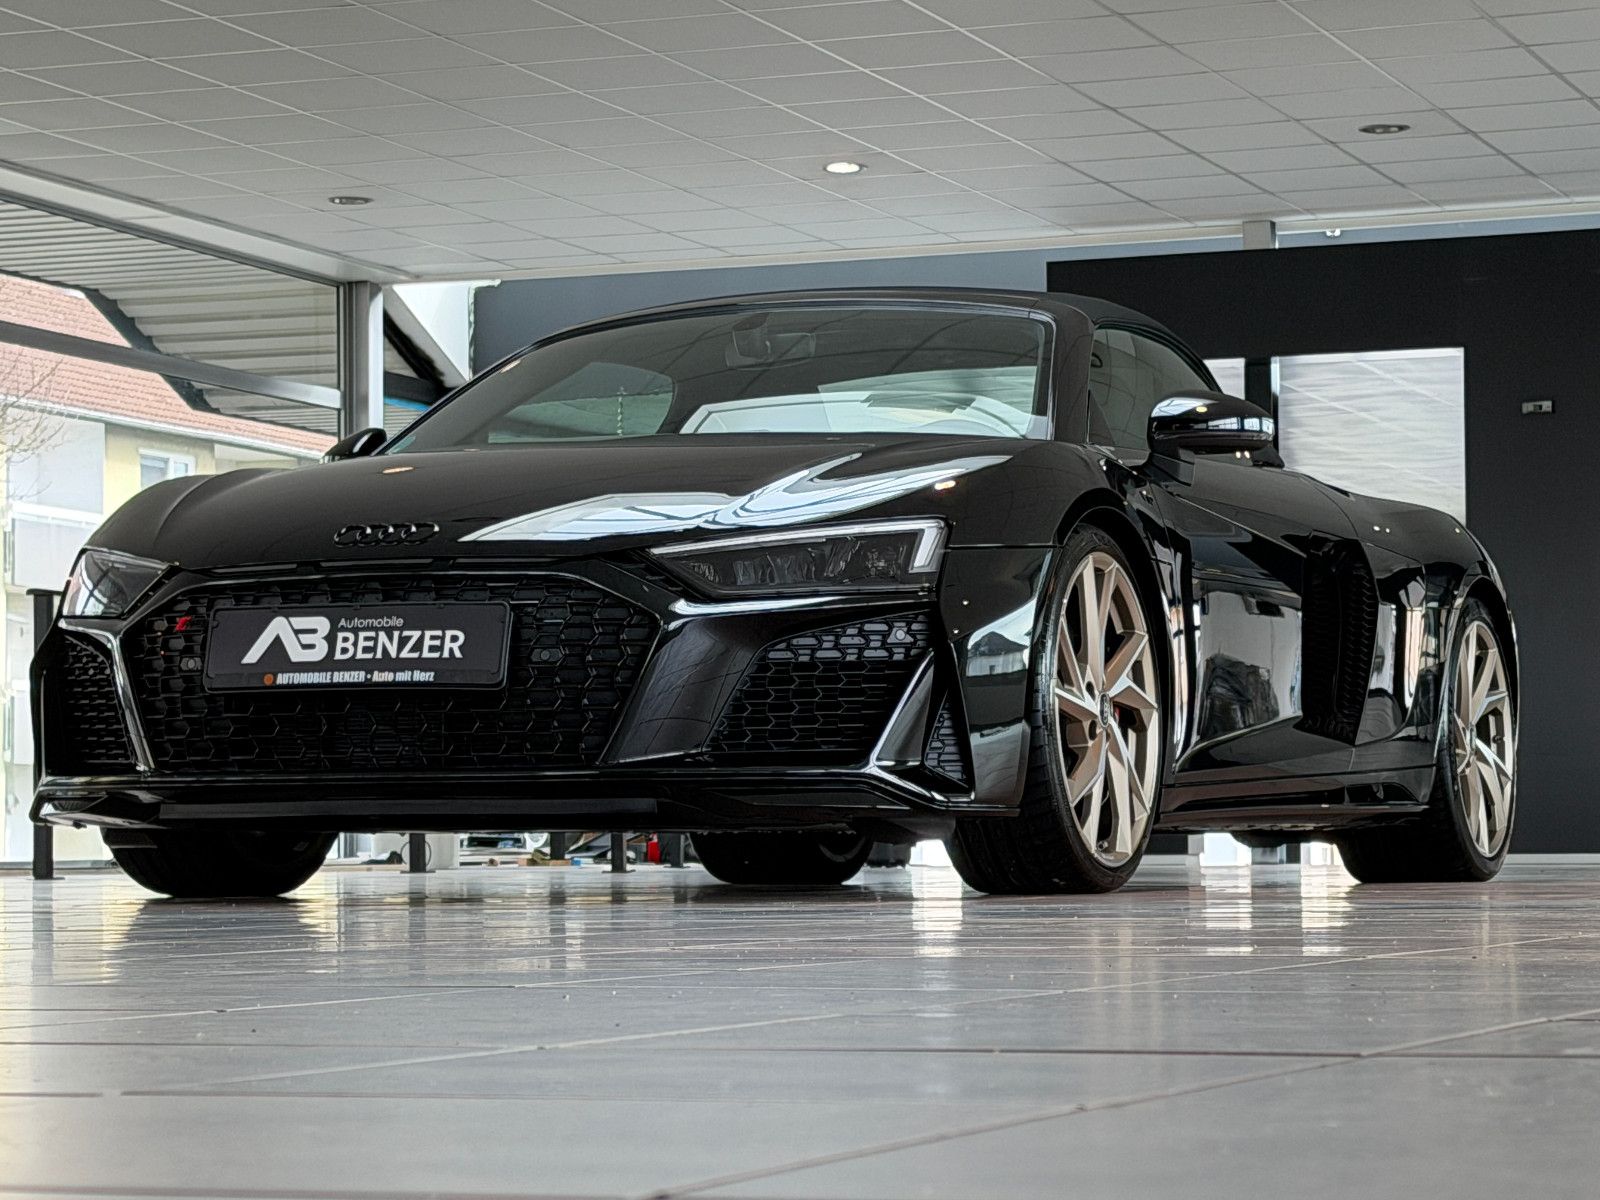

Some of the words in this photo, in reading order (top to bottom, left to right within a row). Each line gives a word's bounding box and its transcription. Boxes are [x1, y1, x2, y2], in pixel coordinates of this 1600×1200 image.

[337, 615, 404, 628] Automobile
[333, 629, 466, 660] BENZER
[275, 671, 332, 685] AUTOMOBILE
[332, 670, 366, 683] BENZER
[371, 670, 394, 682] Auto
[395, 670, 412, 682] mit
[412, 669, 435, 682] Herz
